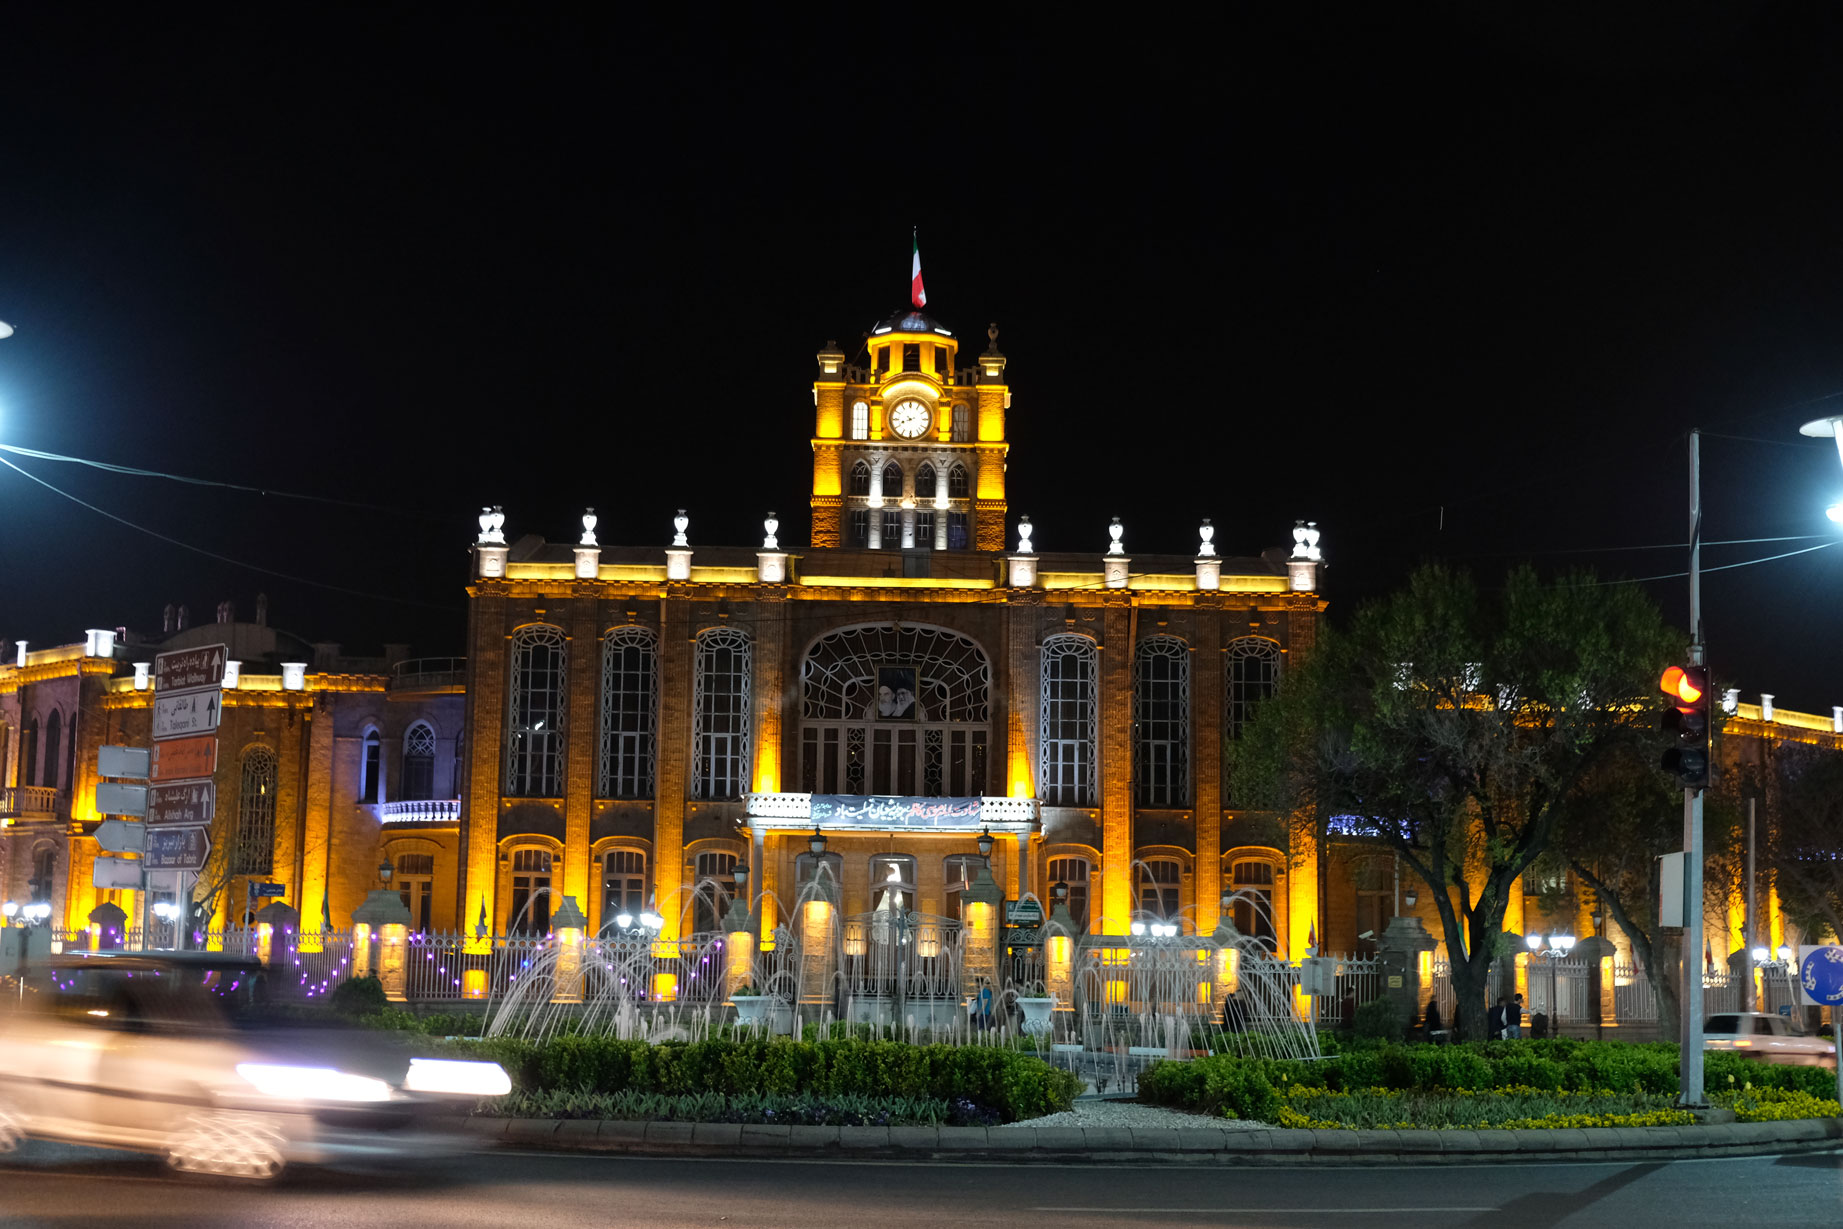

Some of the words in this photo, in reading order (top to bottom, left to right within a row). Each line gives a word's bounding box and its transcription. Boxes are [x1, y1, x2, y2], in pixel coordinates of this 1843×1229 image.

[171, 698, 189, 717] طالقانی
[170, 719, 189, 731] Taleqani
[164, 788, 180, 804] علیشاه
[180, 787, 190, 805] ارگ
[183, 808, 194, 821] Arg
[952, 801, 980, 816] شهادت
[161, 854, 176, 864] Bazaar
[177, 853, 182, 864] of
[184, 853, 197, 864] Tabriz
